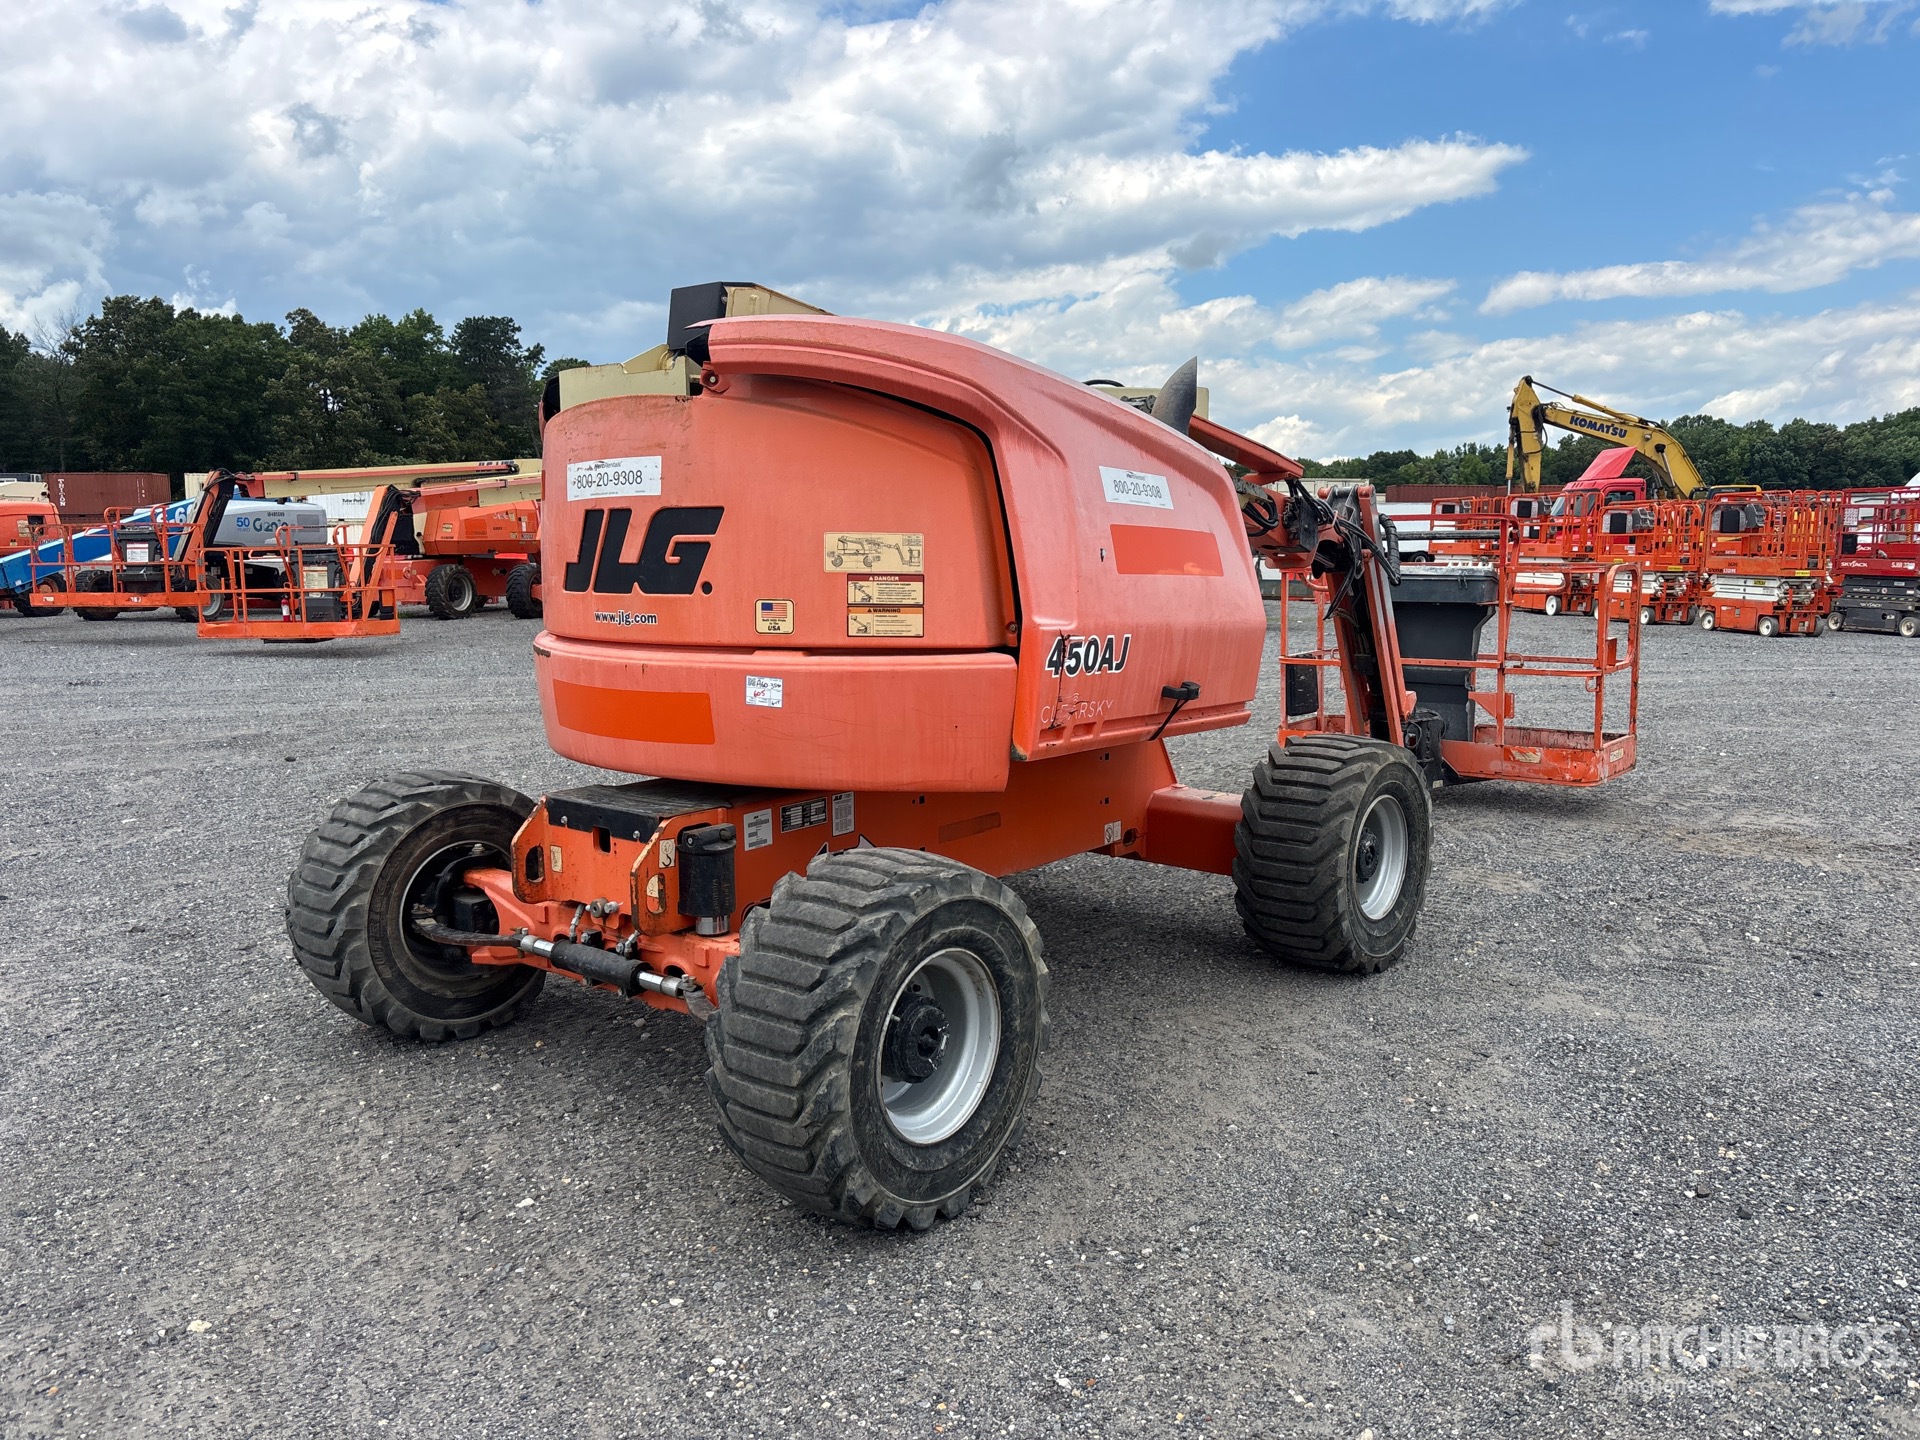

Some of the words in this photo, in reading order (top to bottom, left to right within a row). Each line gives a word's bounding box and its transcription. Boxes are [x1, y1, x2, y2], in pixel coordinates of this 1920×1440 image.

[1569, 415, 1628, 439] KOMATSU
[576, 470, 643, 489] 800-20-9308
[1113, 479, 1162, 499] 800-20-9308
[236, 516, 250, 528] 50
[1840, 560, 1868, 568] SKYJACK
[594, 611, 658, 626] www.jlg.com
[1045, 634, 1132, 678] 450AJ
